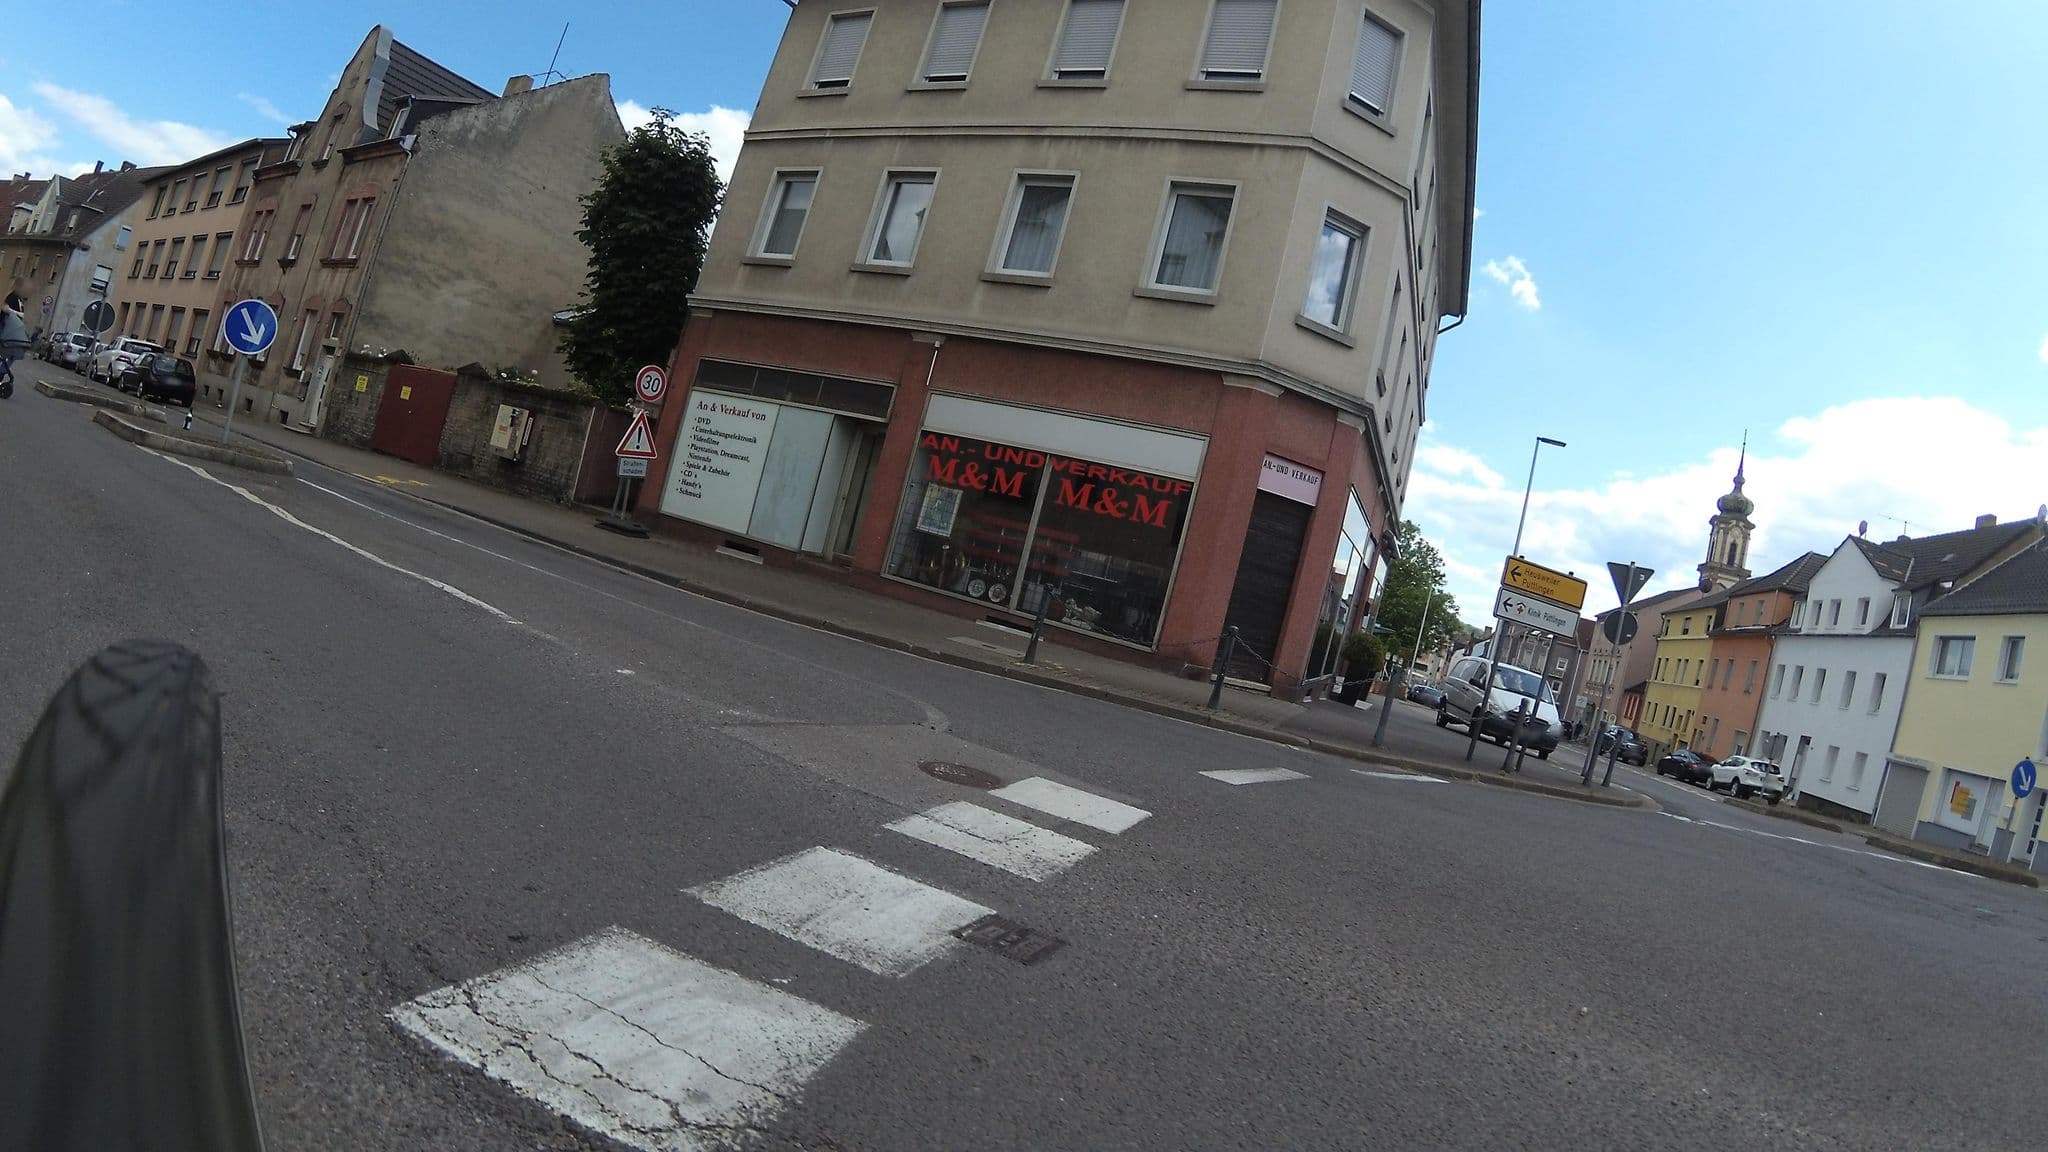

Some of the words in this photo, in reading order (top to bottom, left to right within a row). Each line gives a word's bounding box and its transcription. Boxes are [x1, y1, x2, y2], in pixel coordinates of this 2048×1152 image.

[643, 375, 660, 393] 30
[696, 401, 708, 411] An
[710, 404, 718, 412] &
[720, 404, 751, 418] Verkauf
[751, 412, 766, 421] von
[697, 417, 711, 425] DVD
[926, 454, 1028, 498] M&M
[985, 444, 1046, 469] UND
[1051, 456, 1192, 497] VERKAUF
[1291, 469, 1319, 485] VERKAUF
[1055, 477, 1173, 528] M&M
[1524, 567, 1561, 586] Heusweiler
